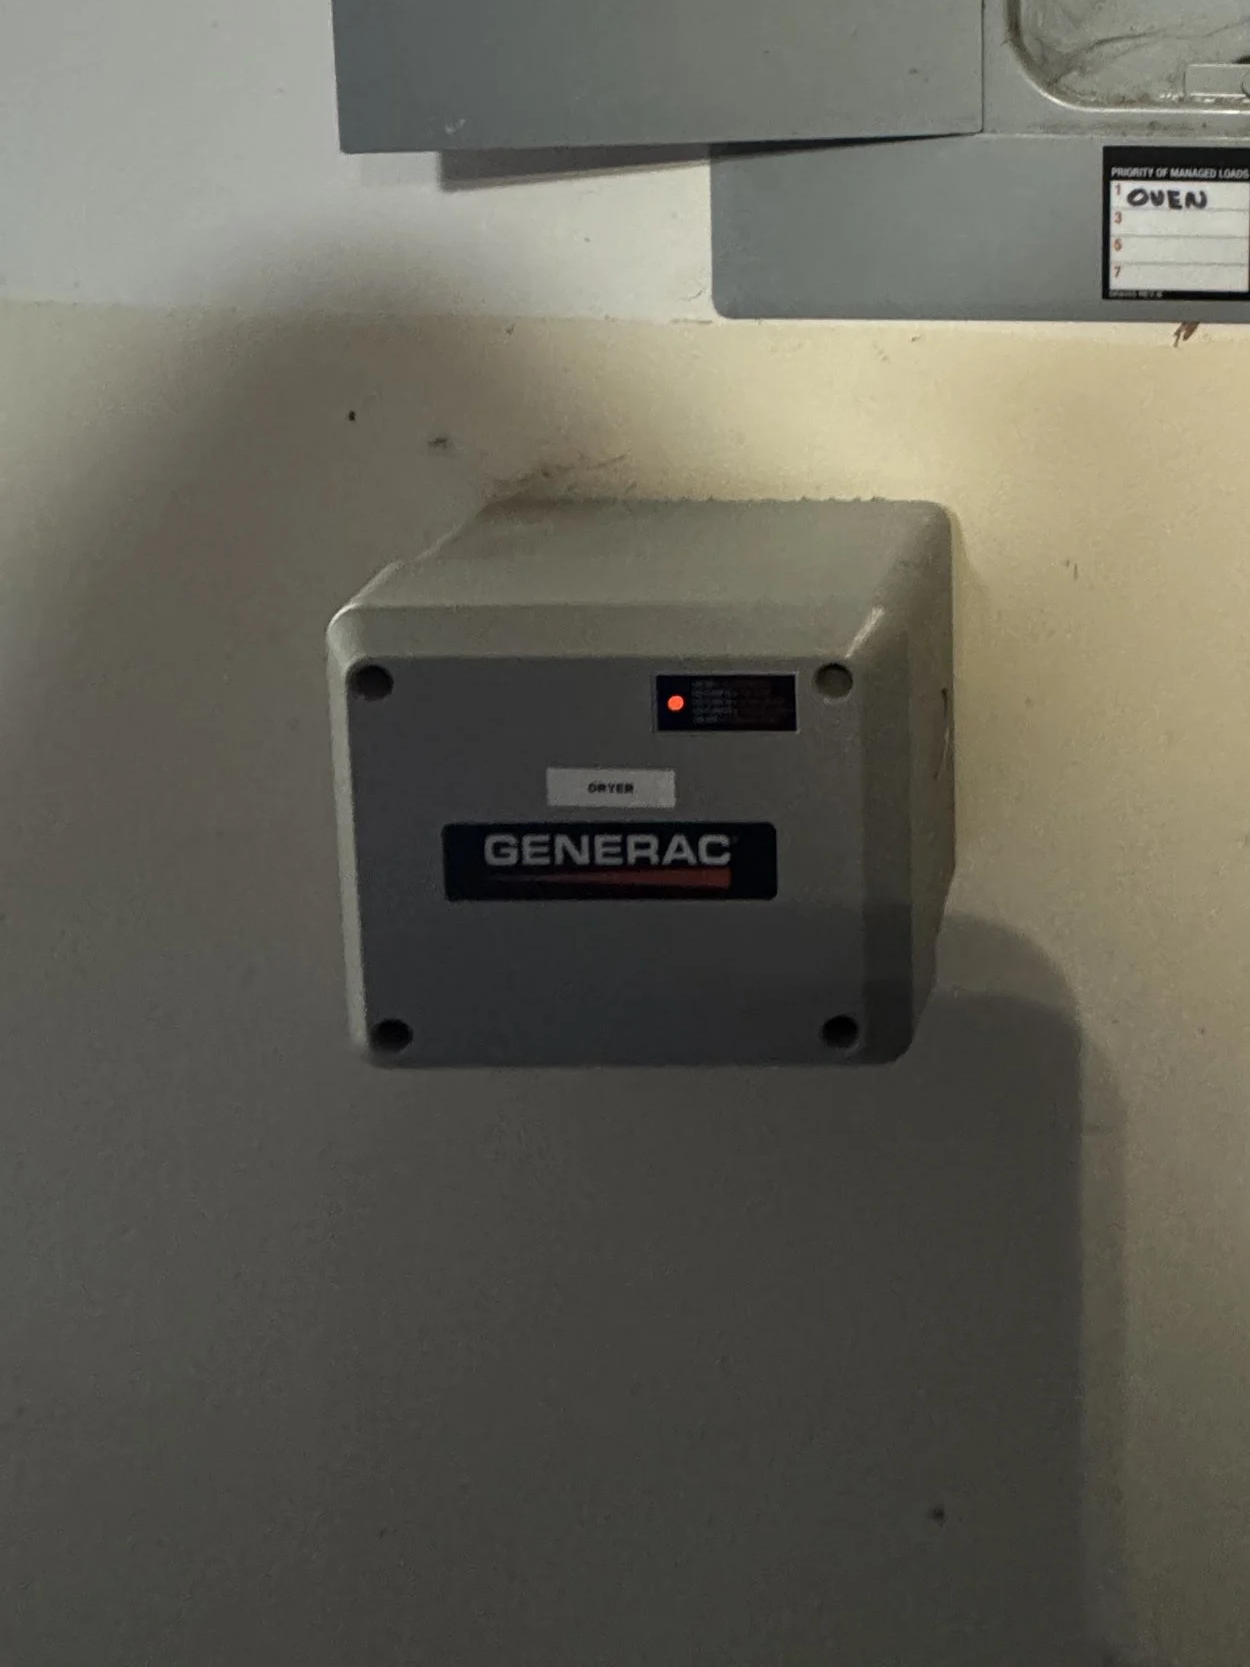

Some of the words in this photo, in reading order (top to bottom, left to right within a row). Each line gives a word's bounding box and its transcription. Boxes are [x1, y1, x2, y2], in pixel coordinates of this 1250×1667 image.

[1110, 167, 1154, 178] PRIORITY
[1156, 168, 1168, 178] OF
[1170, 168, 1217, 179] MANAGED
[1218, 169, 1250, 179] LOADS
[1115, 184, 1122, 195] 1
[1126, 188, 1208, 210] OVEN
[1113, 212, 1123, 224] 3
[1113, 239, 1123, 252] 5
[1113, 266, 1121, 278] 7
[587, 782, 635, 795] DRYER
[484, 834, 732, 866] GENERAC
